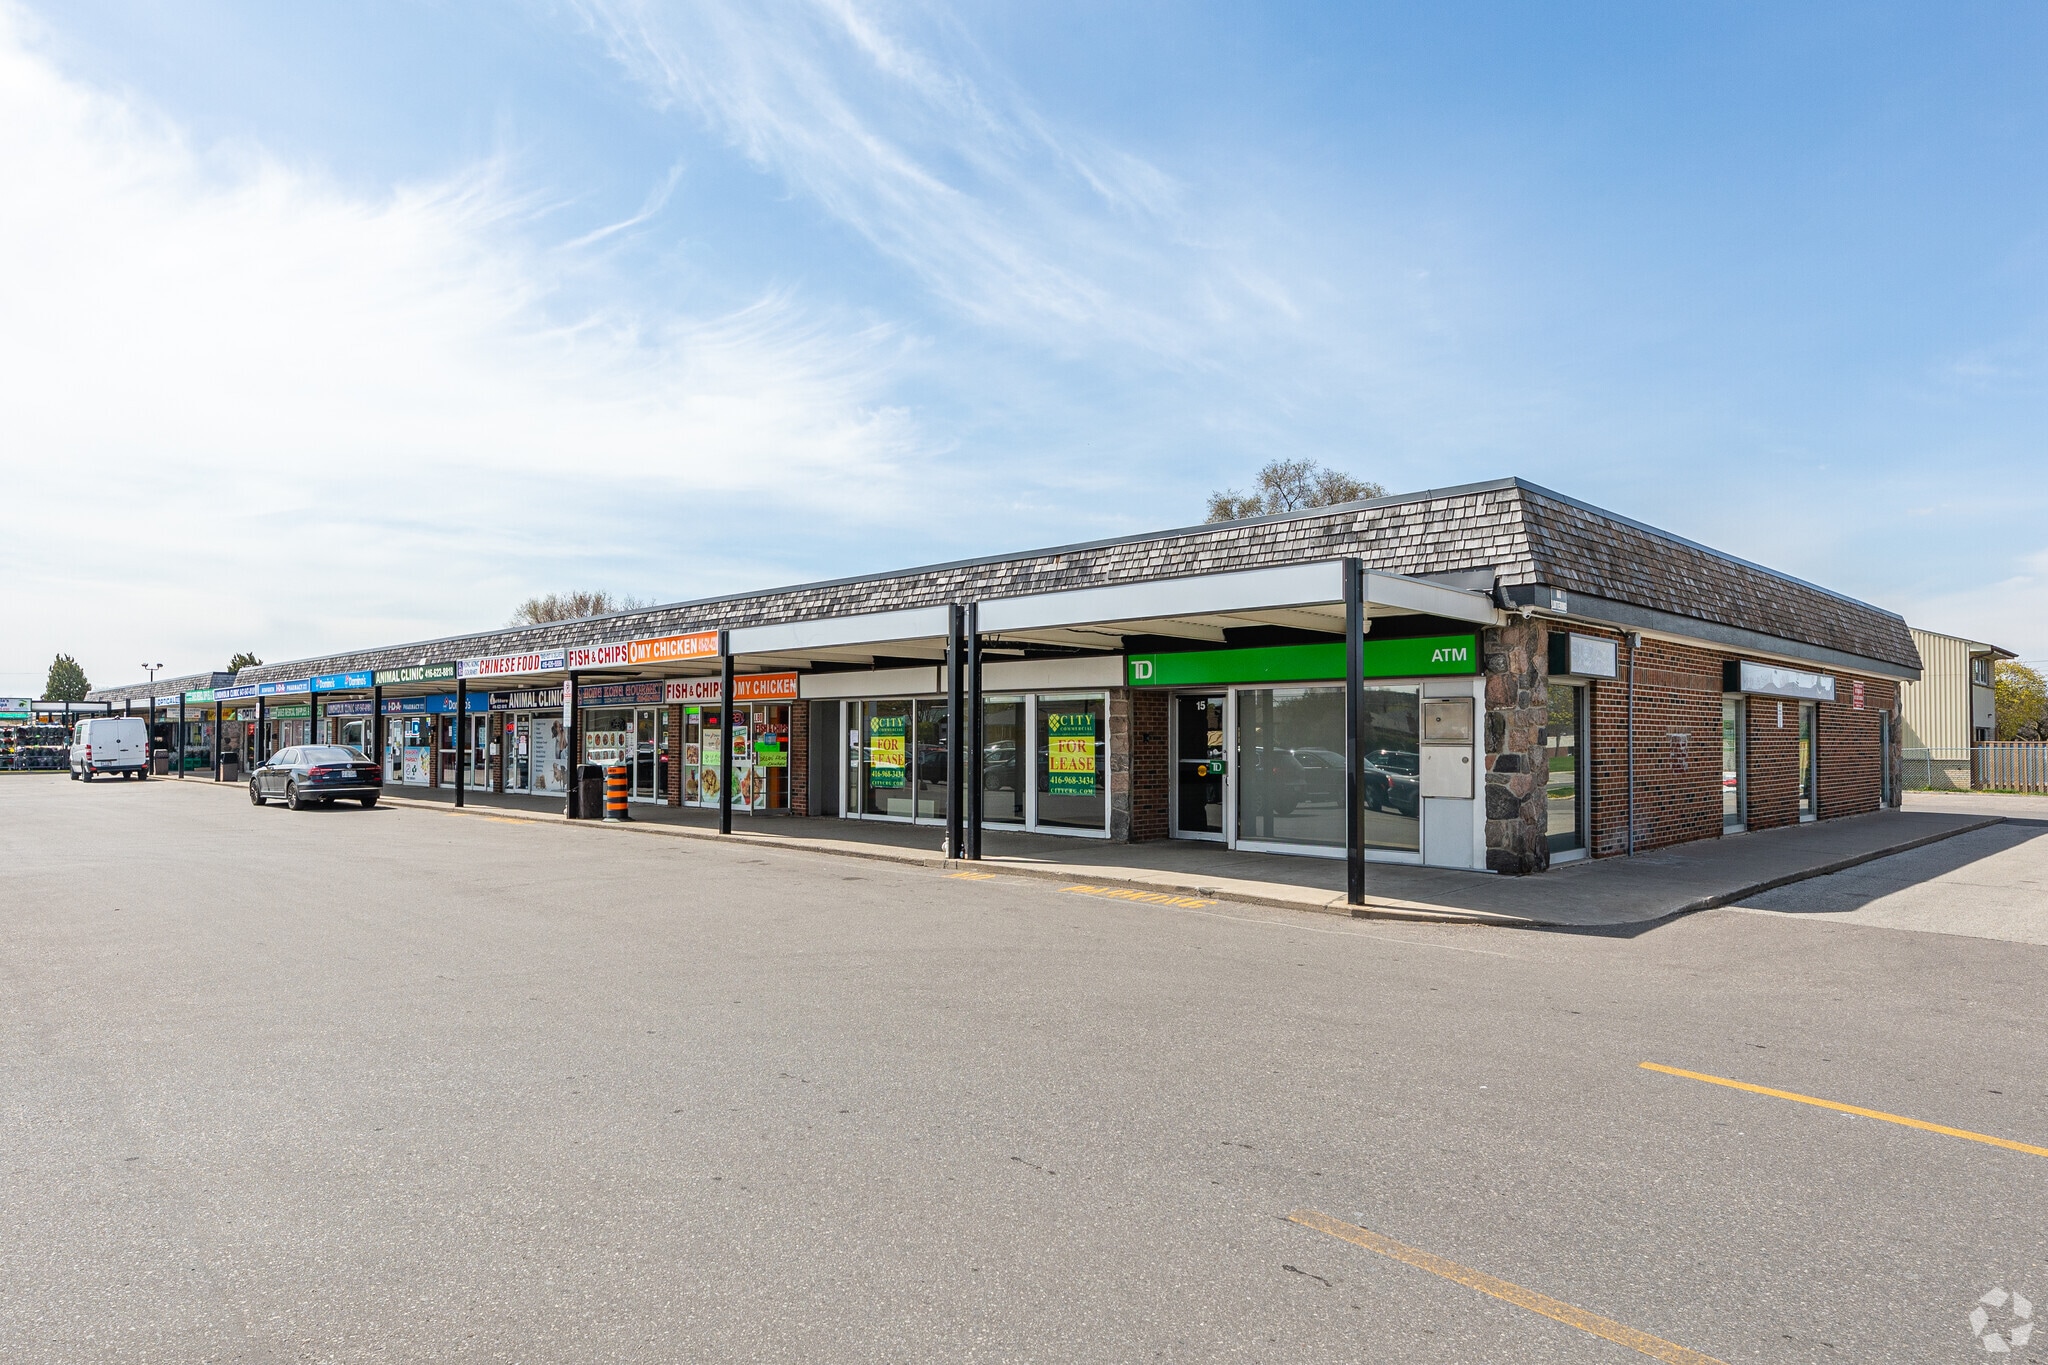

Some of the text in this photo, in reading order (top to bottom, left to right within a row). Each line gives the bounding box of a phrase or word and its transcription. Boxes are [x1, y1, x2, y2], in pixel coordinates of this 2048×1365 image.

[569, 649, 590, 666] FISH
[591, 651, 596, 663] &
[597, 645, 628, 665] CHIPS
[653, 638, 697, 657] CHICKEN
[1431, 647, 1467, 662] ATM
[479, 657, 515, 675] CHINESE
[517, 654, 540, 672] FOOD
[1131, 660, 1153, 679] TD
[349, 675, 367, 686] Domino's
[375, 670, 401, 684] ANIMAL
[400, 667, 424, 682] CLINIC
[320, 678, 335, 688] Domino's
[753, 678, 797, 695] CHICKEN
[666, 684, 688, 699] FISH
[689, 685, 694, 696] &
[508, 691, 537, 708] ANIMAL
[538, 689, 564, 707] CLINIC
[1196, 701, 1206, 710] 15
[879, 717, 904, 727] CITY
[1060, 714, 1093, 726] CITY
[877, 738, 899, 751] FOR
[1057, 739, 1087, 753] FOR
[871, 753, 904, 766] LEASE
[1050, 757, 1094, 771] LEASE
[1211, 762, 1222, 771] TD
[1050, 775, 1094, 785] 416-968-3434
[1050, 787, 1093, 795] CITYCRG.COM
